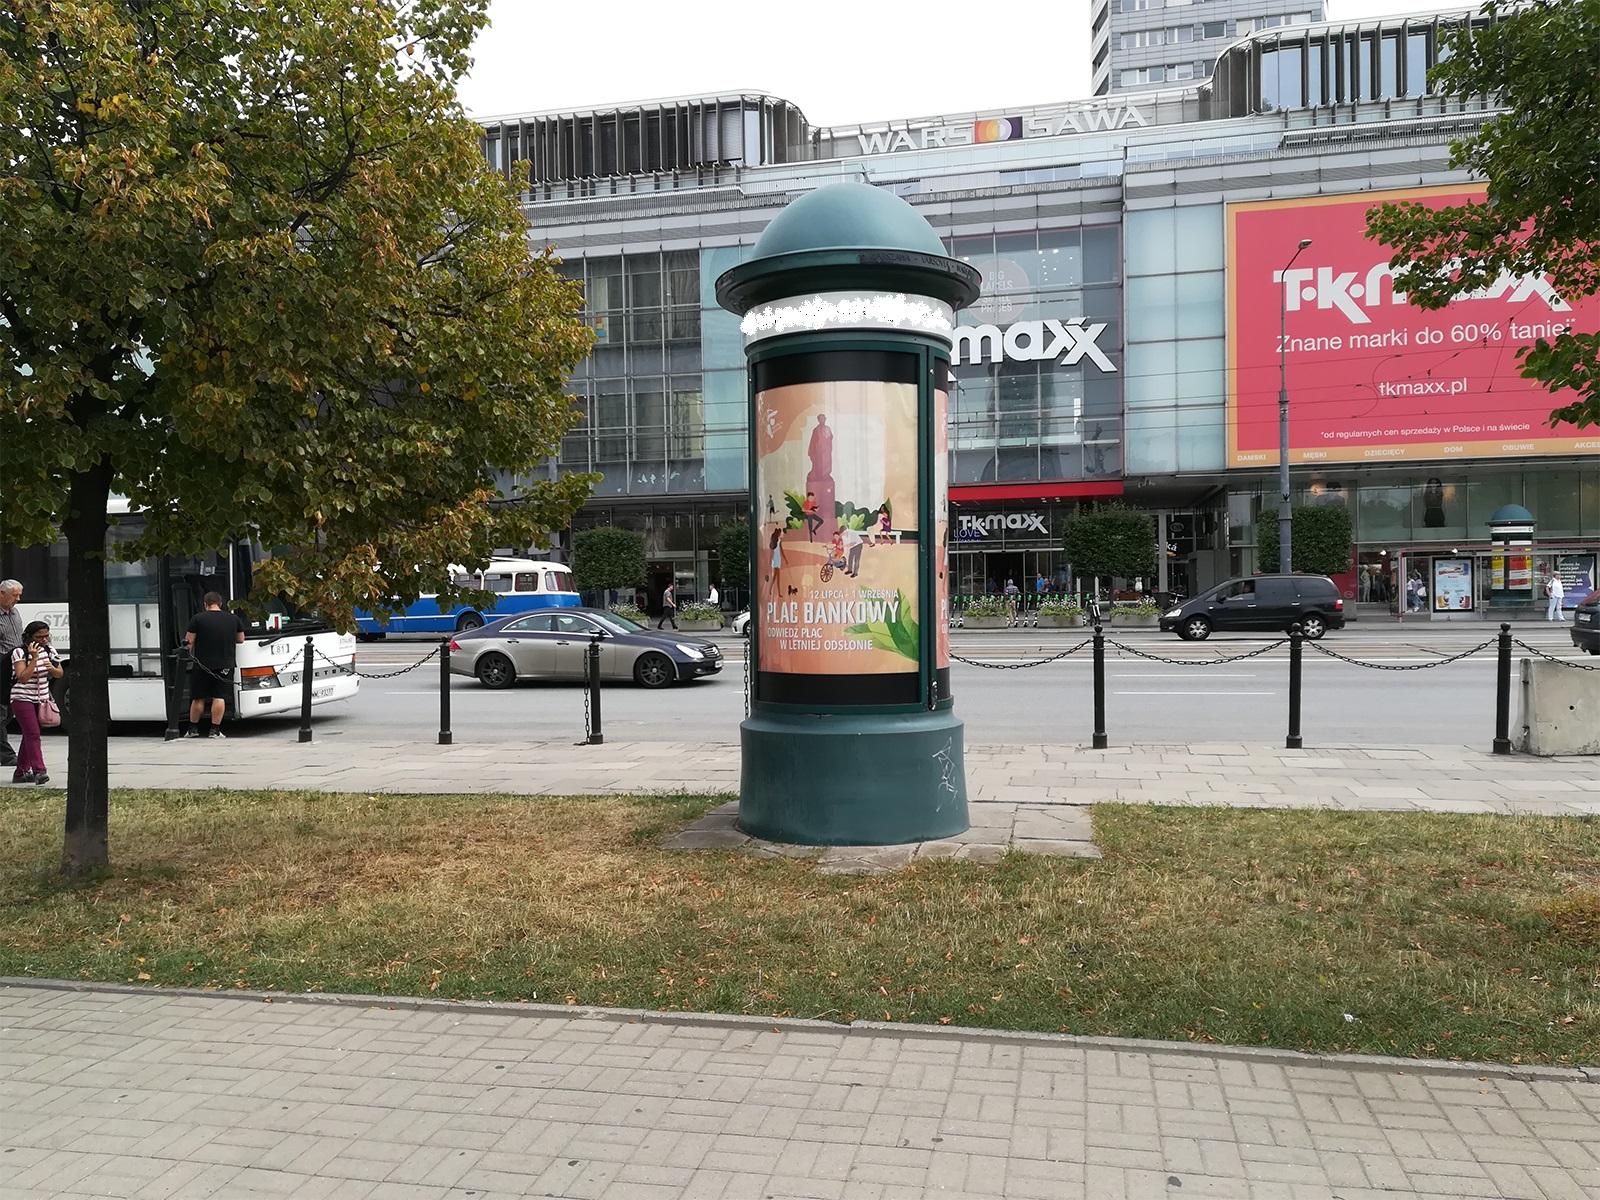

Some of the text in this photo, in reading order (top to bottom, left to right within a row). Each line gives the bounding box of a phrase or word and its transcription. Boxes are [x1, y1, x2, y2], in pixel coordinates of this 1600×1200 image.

[858, 105, 1149, 155] WARS SAWA
[1276, 333, 1343, 353] Znane
[1349, 328, 1408, 348] marki
[1415, 326, 1444, 344] do
[1451, 322, 1502, 342] 60%
[950, 317, 1118, 382] maxx
[1379, 377, 1468, 397] tkmaxx.pl
[1336, 429, 1382, 440] regularnych
[1400, 425, 1442, 436] sprzedaży
[1453, 425, 1480, 433] Polsce
[1499, 422, 1530, 431] świecie
[1237, 454, 1266, 462] DAMSKI
[1502, 443, 1535, 451] OBUWIE
[810, 590, 819, 599] 12
[822, 590, 844, 599] LIPCA
[767, 600, 899, 624] PLAC BANKOWY
[801, 627, 823, 638] PLAC
[780, 639, 873, 651] W LETNIEJ ODSŁONIE
[315, 668, 345, 677] ETR
